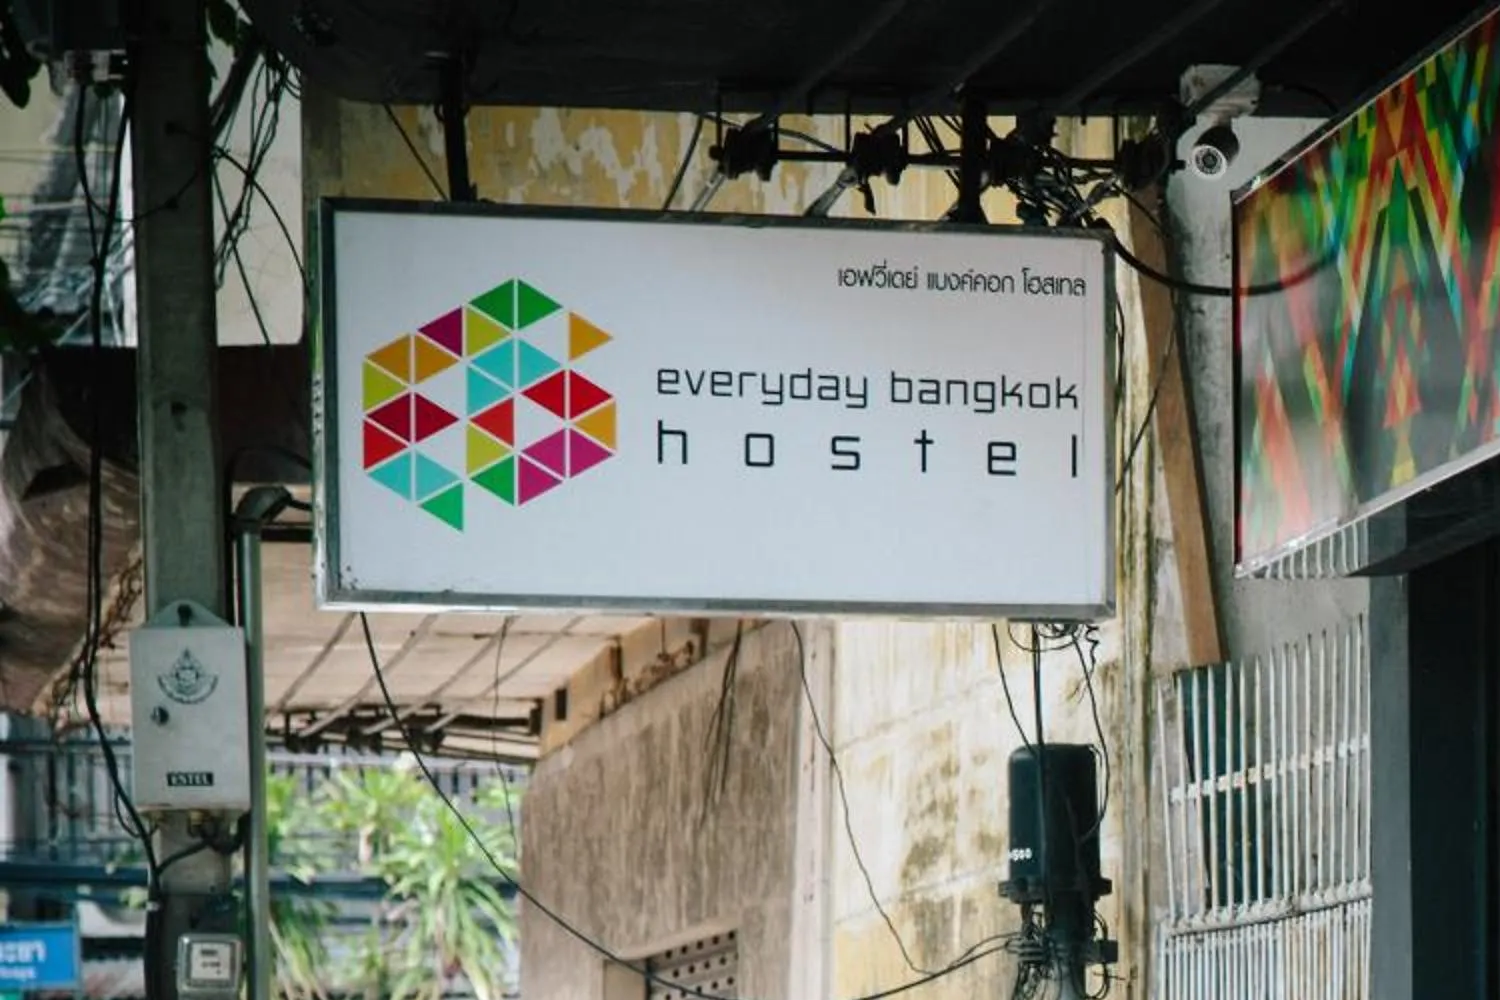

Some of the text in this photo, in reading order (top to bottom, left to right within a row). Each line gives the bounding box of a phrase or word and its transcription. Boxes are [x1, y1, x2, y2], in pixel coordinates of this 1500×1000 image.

[927, 268, 1015, 293] แบงค์คอก
[1021, 266, 1087, 297] โฮสเทล
[657, 367, 1079, 413] everyday bangkok
[657, 419, 1078, 478] hostel
